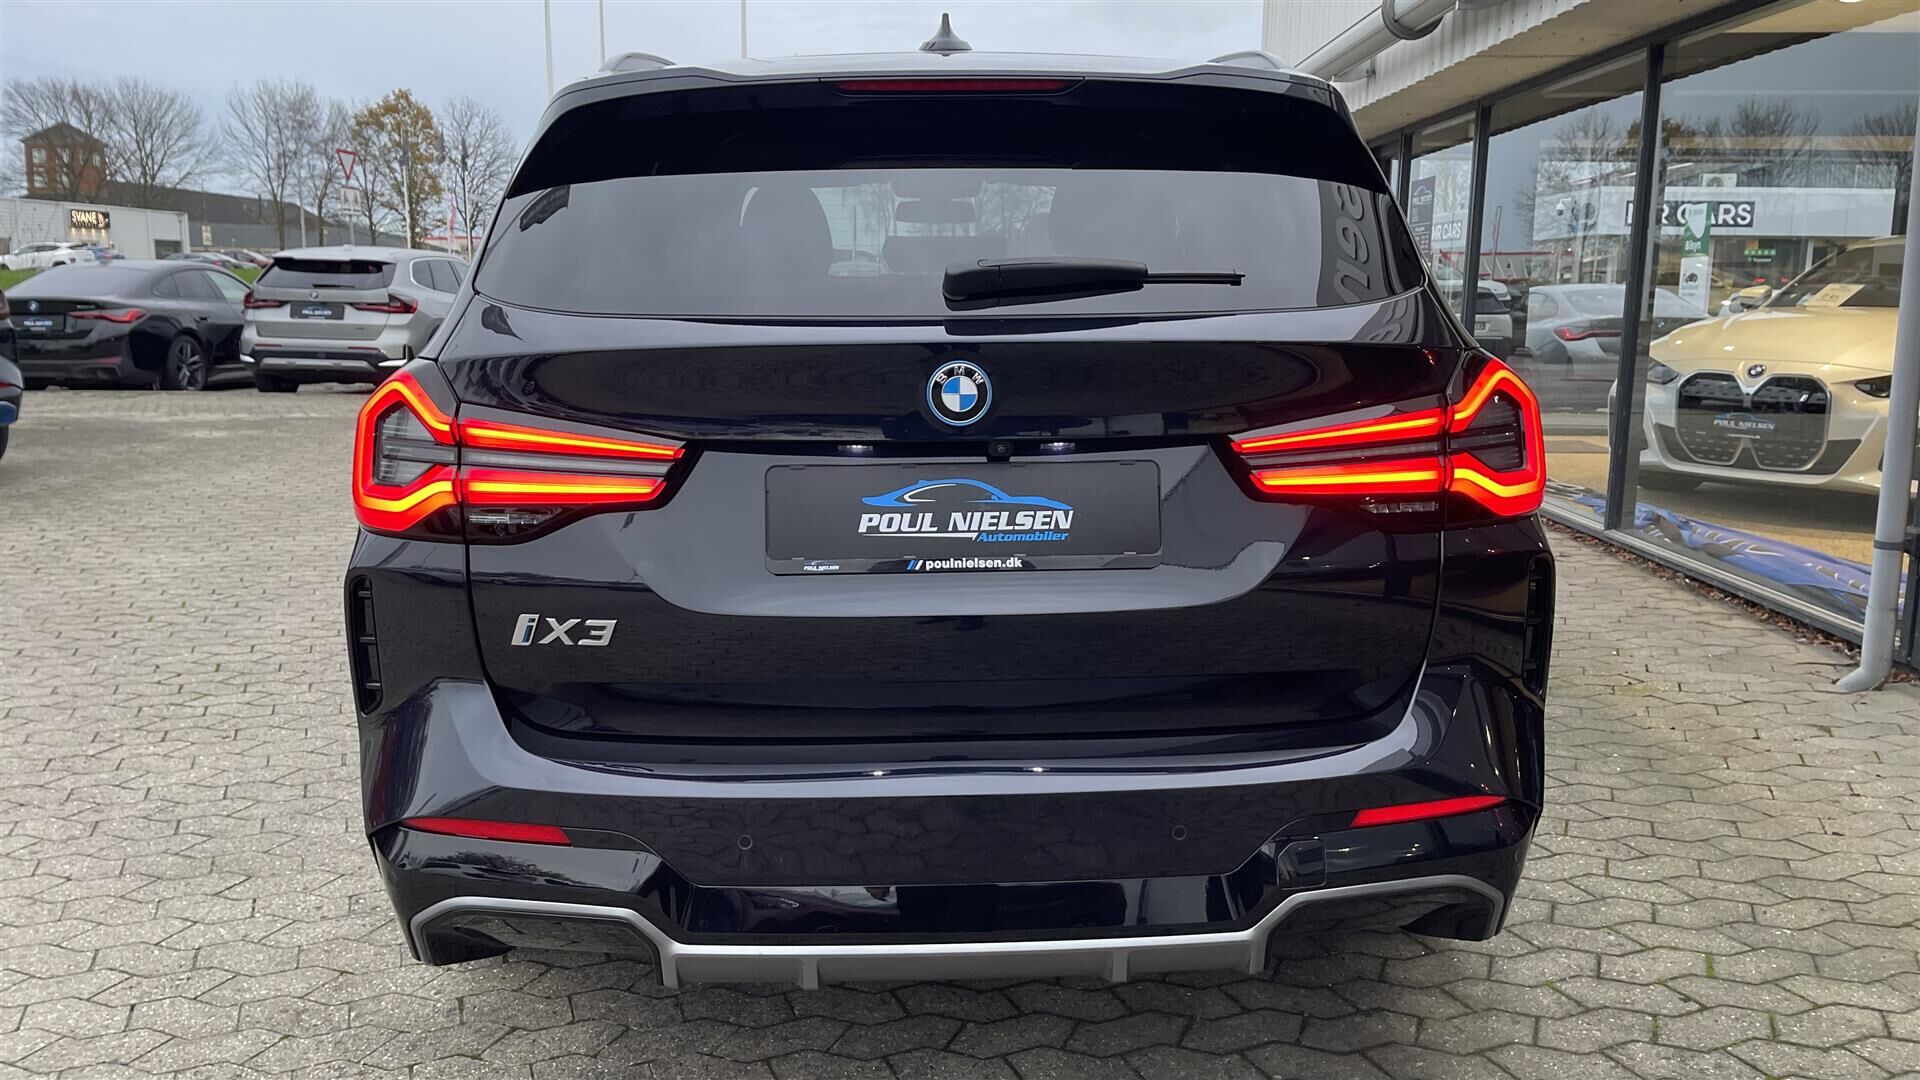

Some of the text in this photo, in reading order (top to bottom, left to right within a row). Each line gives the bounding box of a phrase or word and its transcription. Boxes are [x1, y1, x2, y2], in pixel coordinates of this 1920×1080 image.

[1442, 222, 1462, 239] CARS
[936, 366, 984, 385] BMW
[858, 509, 1074, 533] POUL NIELSEN
[977, 532, 1070, 542] Automobiler
[925, 557, 1023, 571] poulnielsen.dk
[511, 613, 618, 646] iX3
